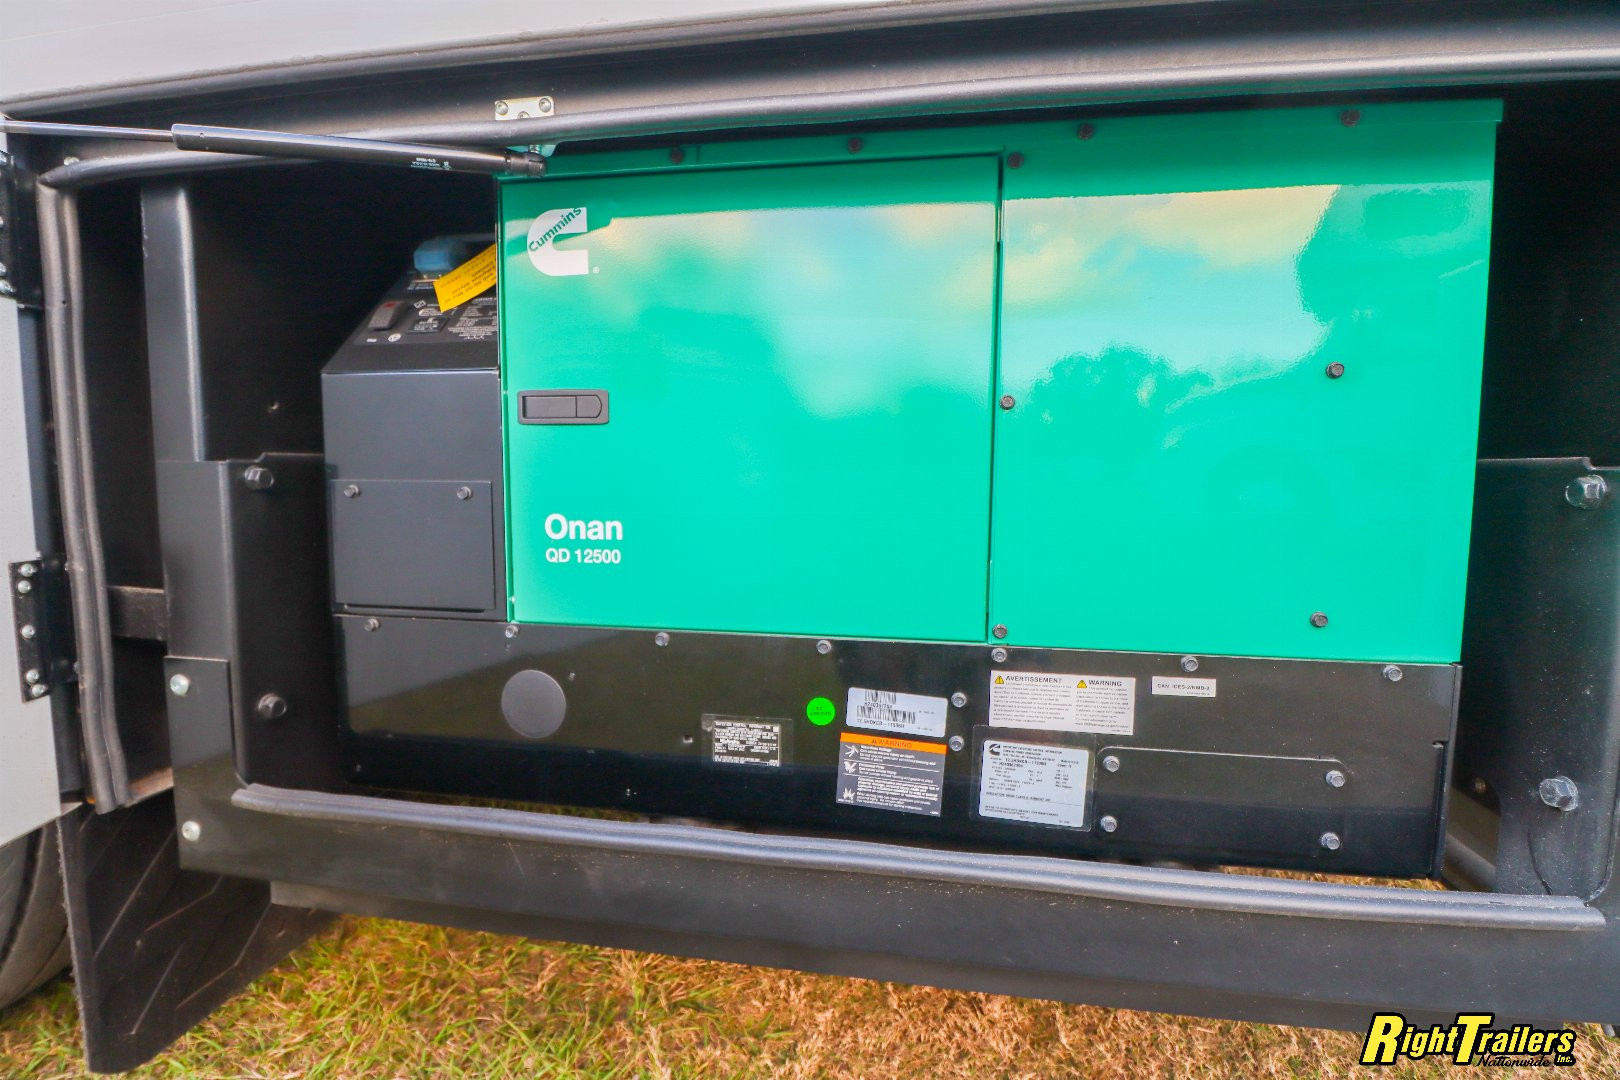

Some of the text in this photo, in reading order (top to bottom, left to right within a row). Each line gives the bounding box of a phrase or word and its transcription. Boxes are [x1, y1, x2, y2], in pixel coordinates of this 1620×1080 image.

[528, 207, 582, 252] Cummins
[544, 513, 623, 541] Onan
[545, 548, 622, 564] QD 12500
[1005, 675, 1062, 684] AVERTISSEMENT
[1088, 679, 1122, 687] WARNING
[878, 739, 913, 749] WARNING
